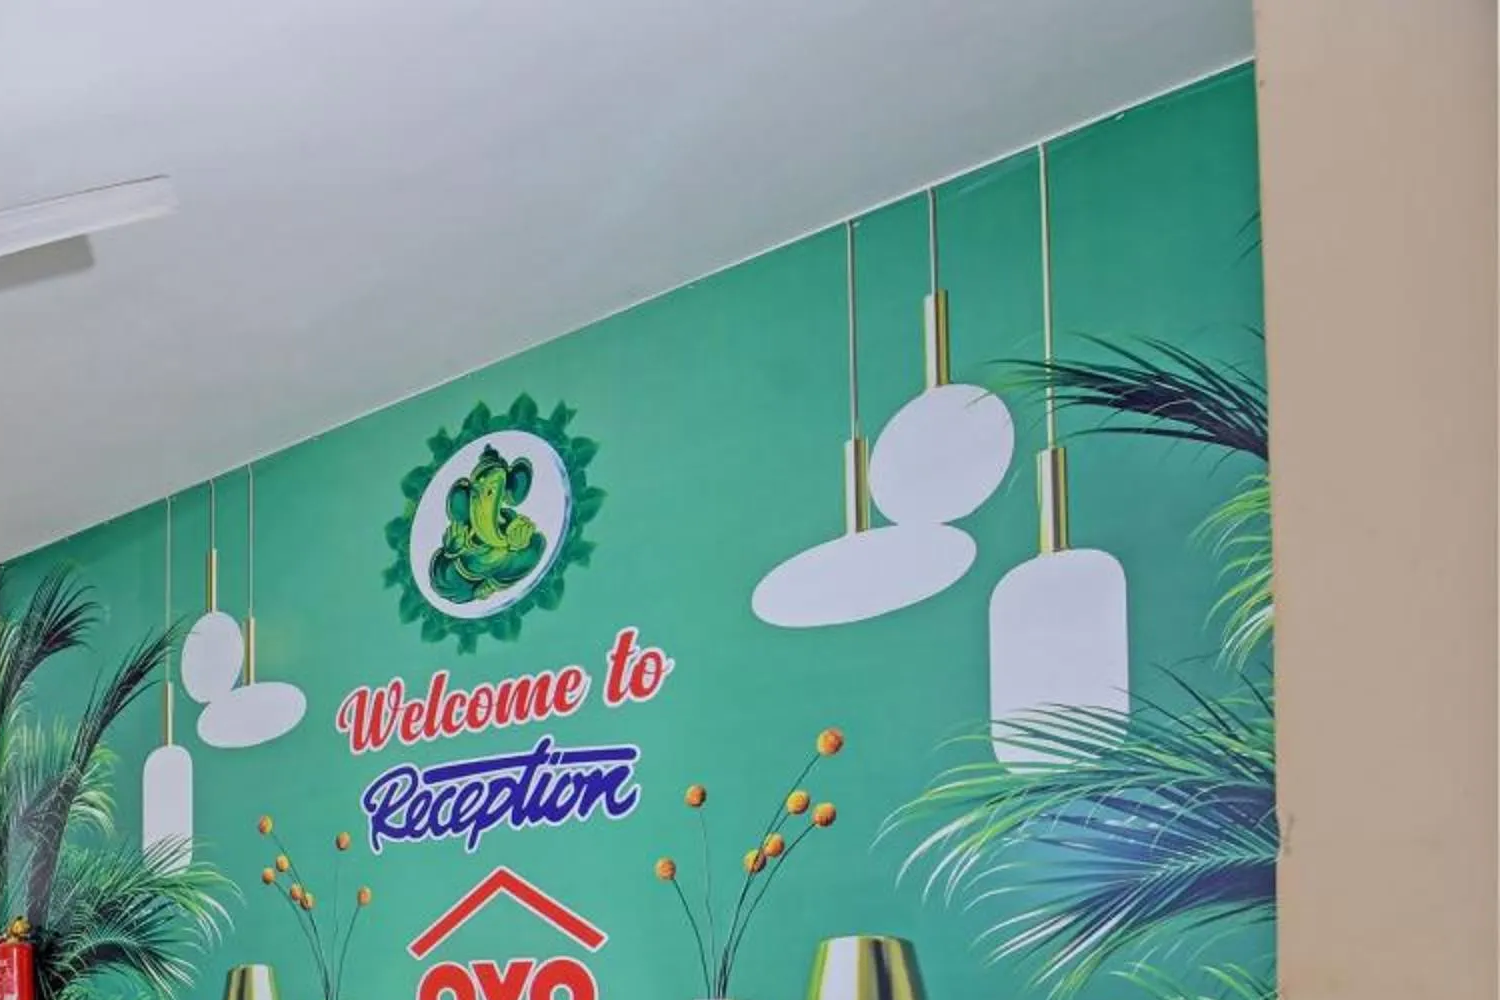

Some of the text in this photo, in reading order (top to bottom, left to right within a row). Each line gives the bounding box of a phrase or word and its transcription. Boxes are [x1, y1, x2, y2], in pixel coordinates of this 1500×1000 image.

[338, 628, 672, 754] Welcome to
[363, 738, 640, 853] Reception
